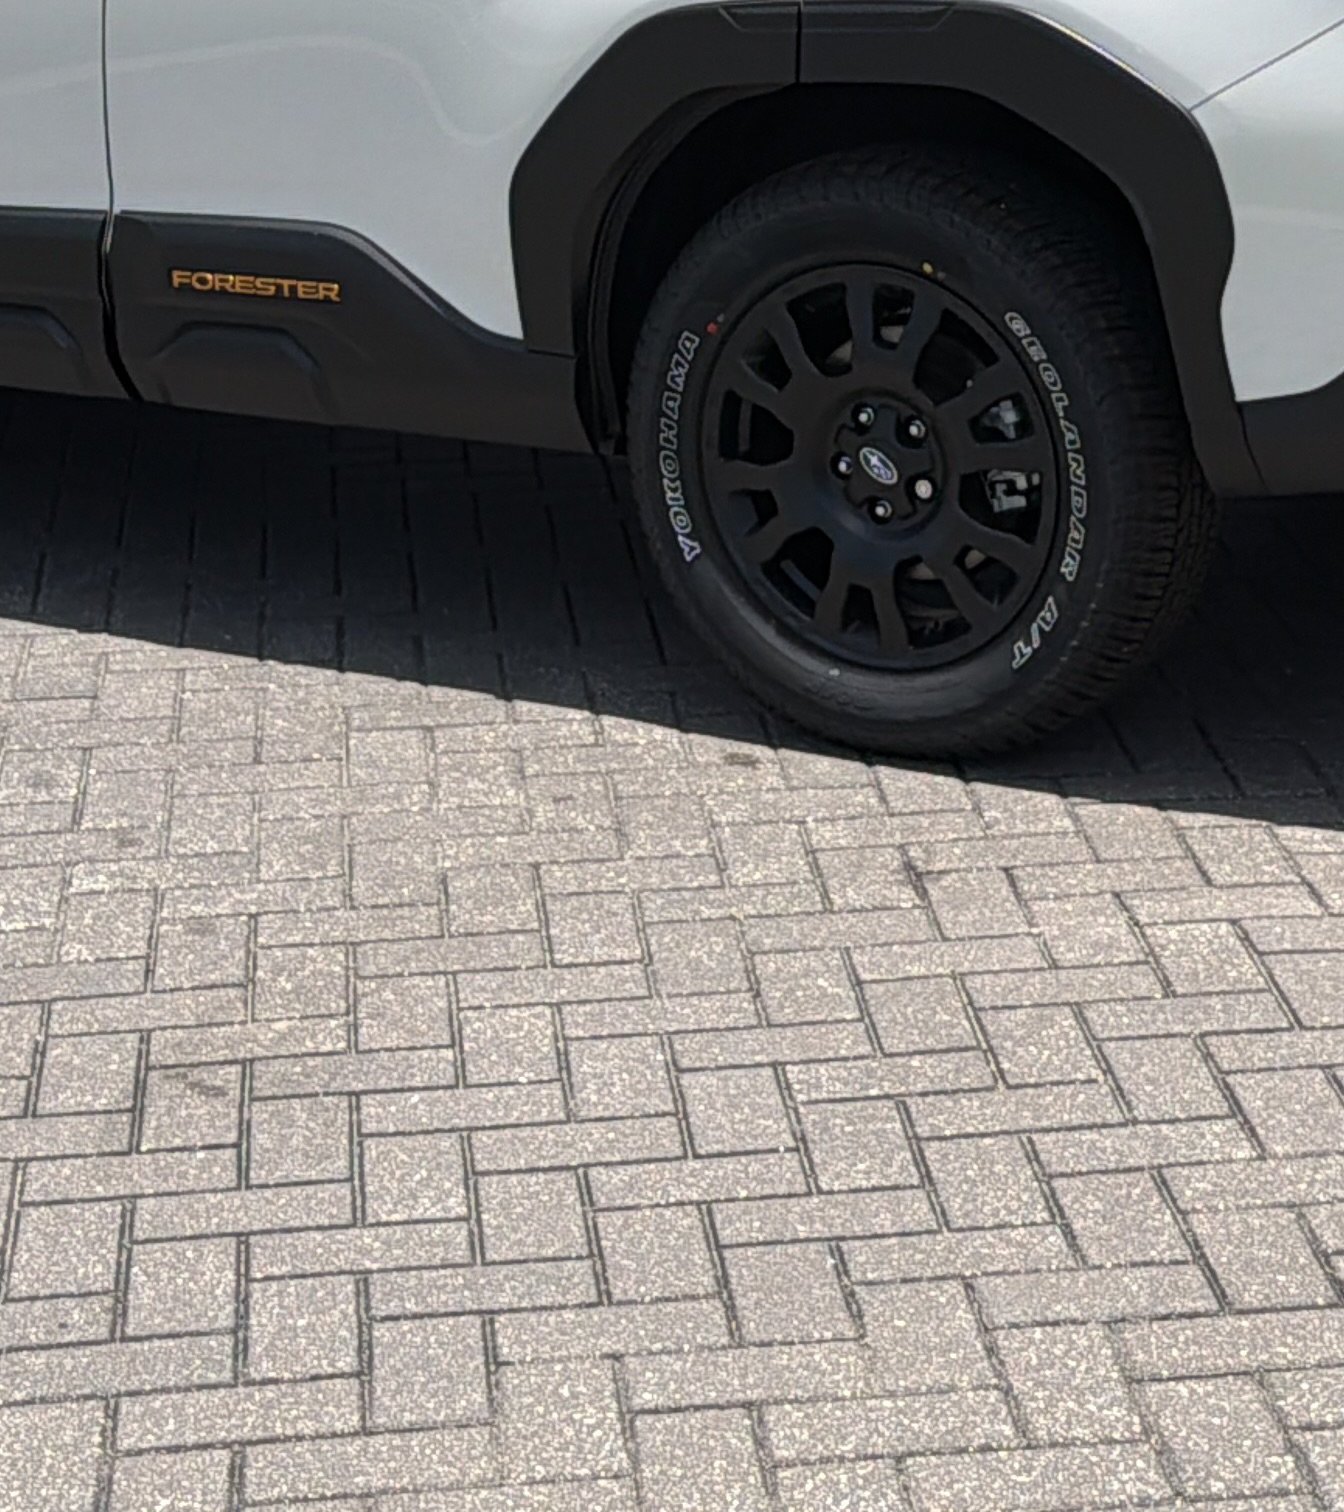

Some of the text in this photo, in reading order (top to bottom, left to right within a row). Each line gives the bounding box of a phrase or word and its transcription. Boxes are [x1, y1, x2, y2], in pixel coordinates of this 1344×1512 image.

[170, 269, 342, 302] FORESTER
[659, 329, 701, 563] YOKOHAMA
[1004, 311, 1087, 670] GEOLANDAR A/T
